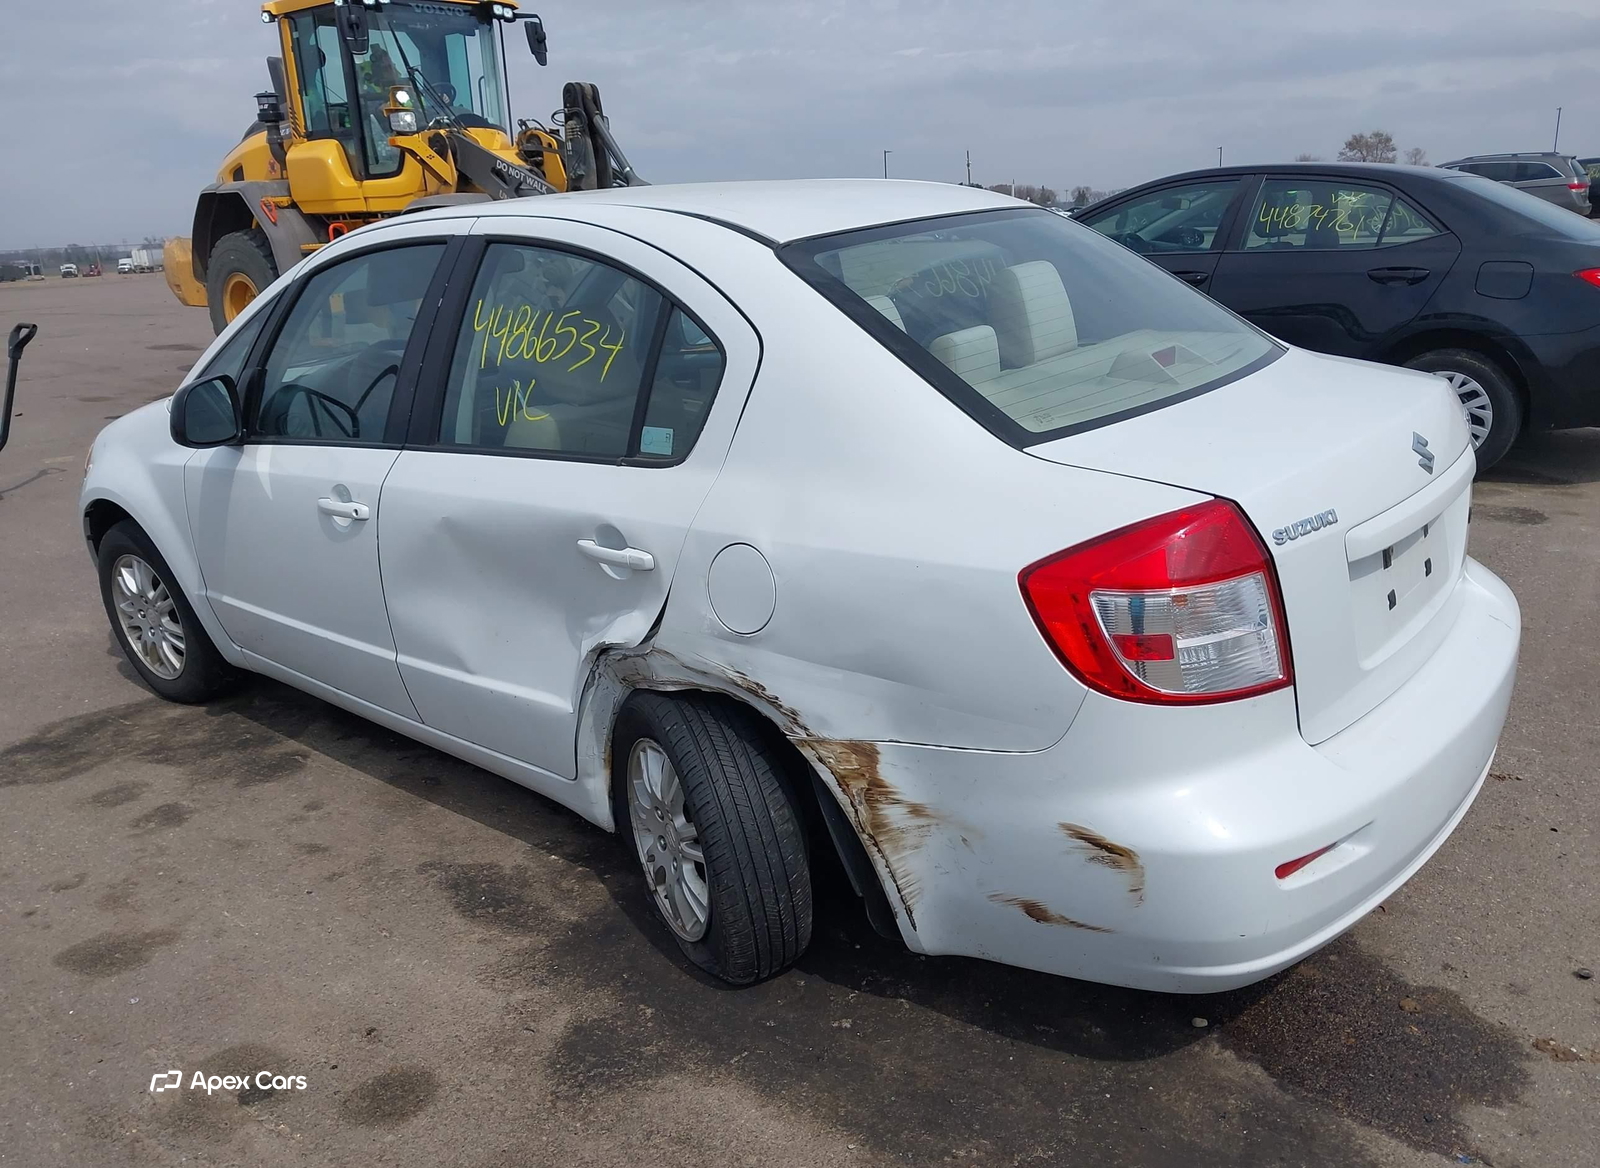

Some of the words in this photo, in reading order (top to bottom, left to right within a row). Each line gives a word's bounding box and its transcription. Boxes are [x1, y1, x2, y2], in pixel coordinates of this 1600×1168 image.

[408, 3, 465, 17] VOLVO
[496, 160, 508, 172] DO
[508, 167, 525, 182] NOT
[526, 175, 548, 195] WALK
[474, 299, 626, 384] 44866534
[1272, 508, 1339, 546] SUZUKI
